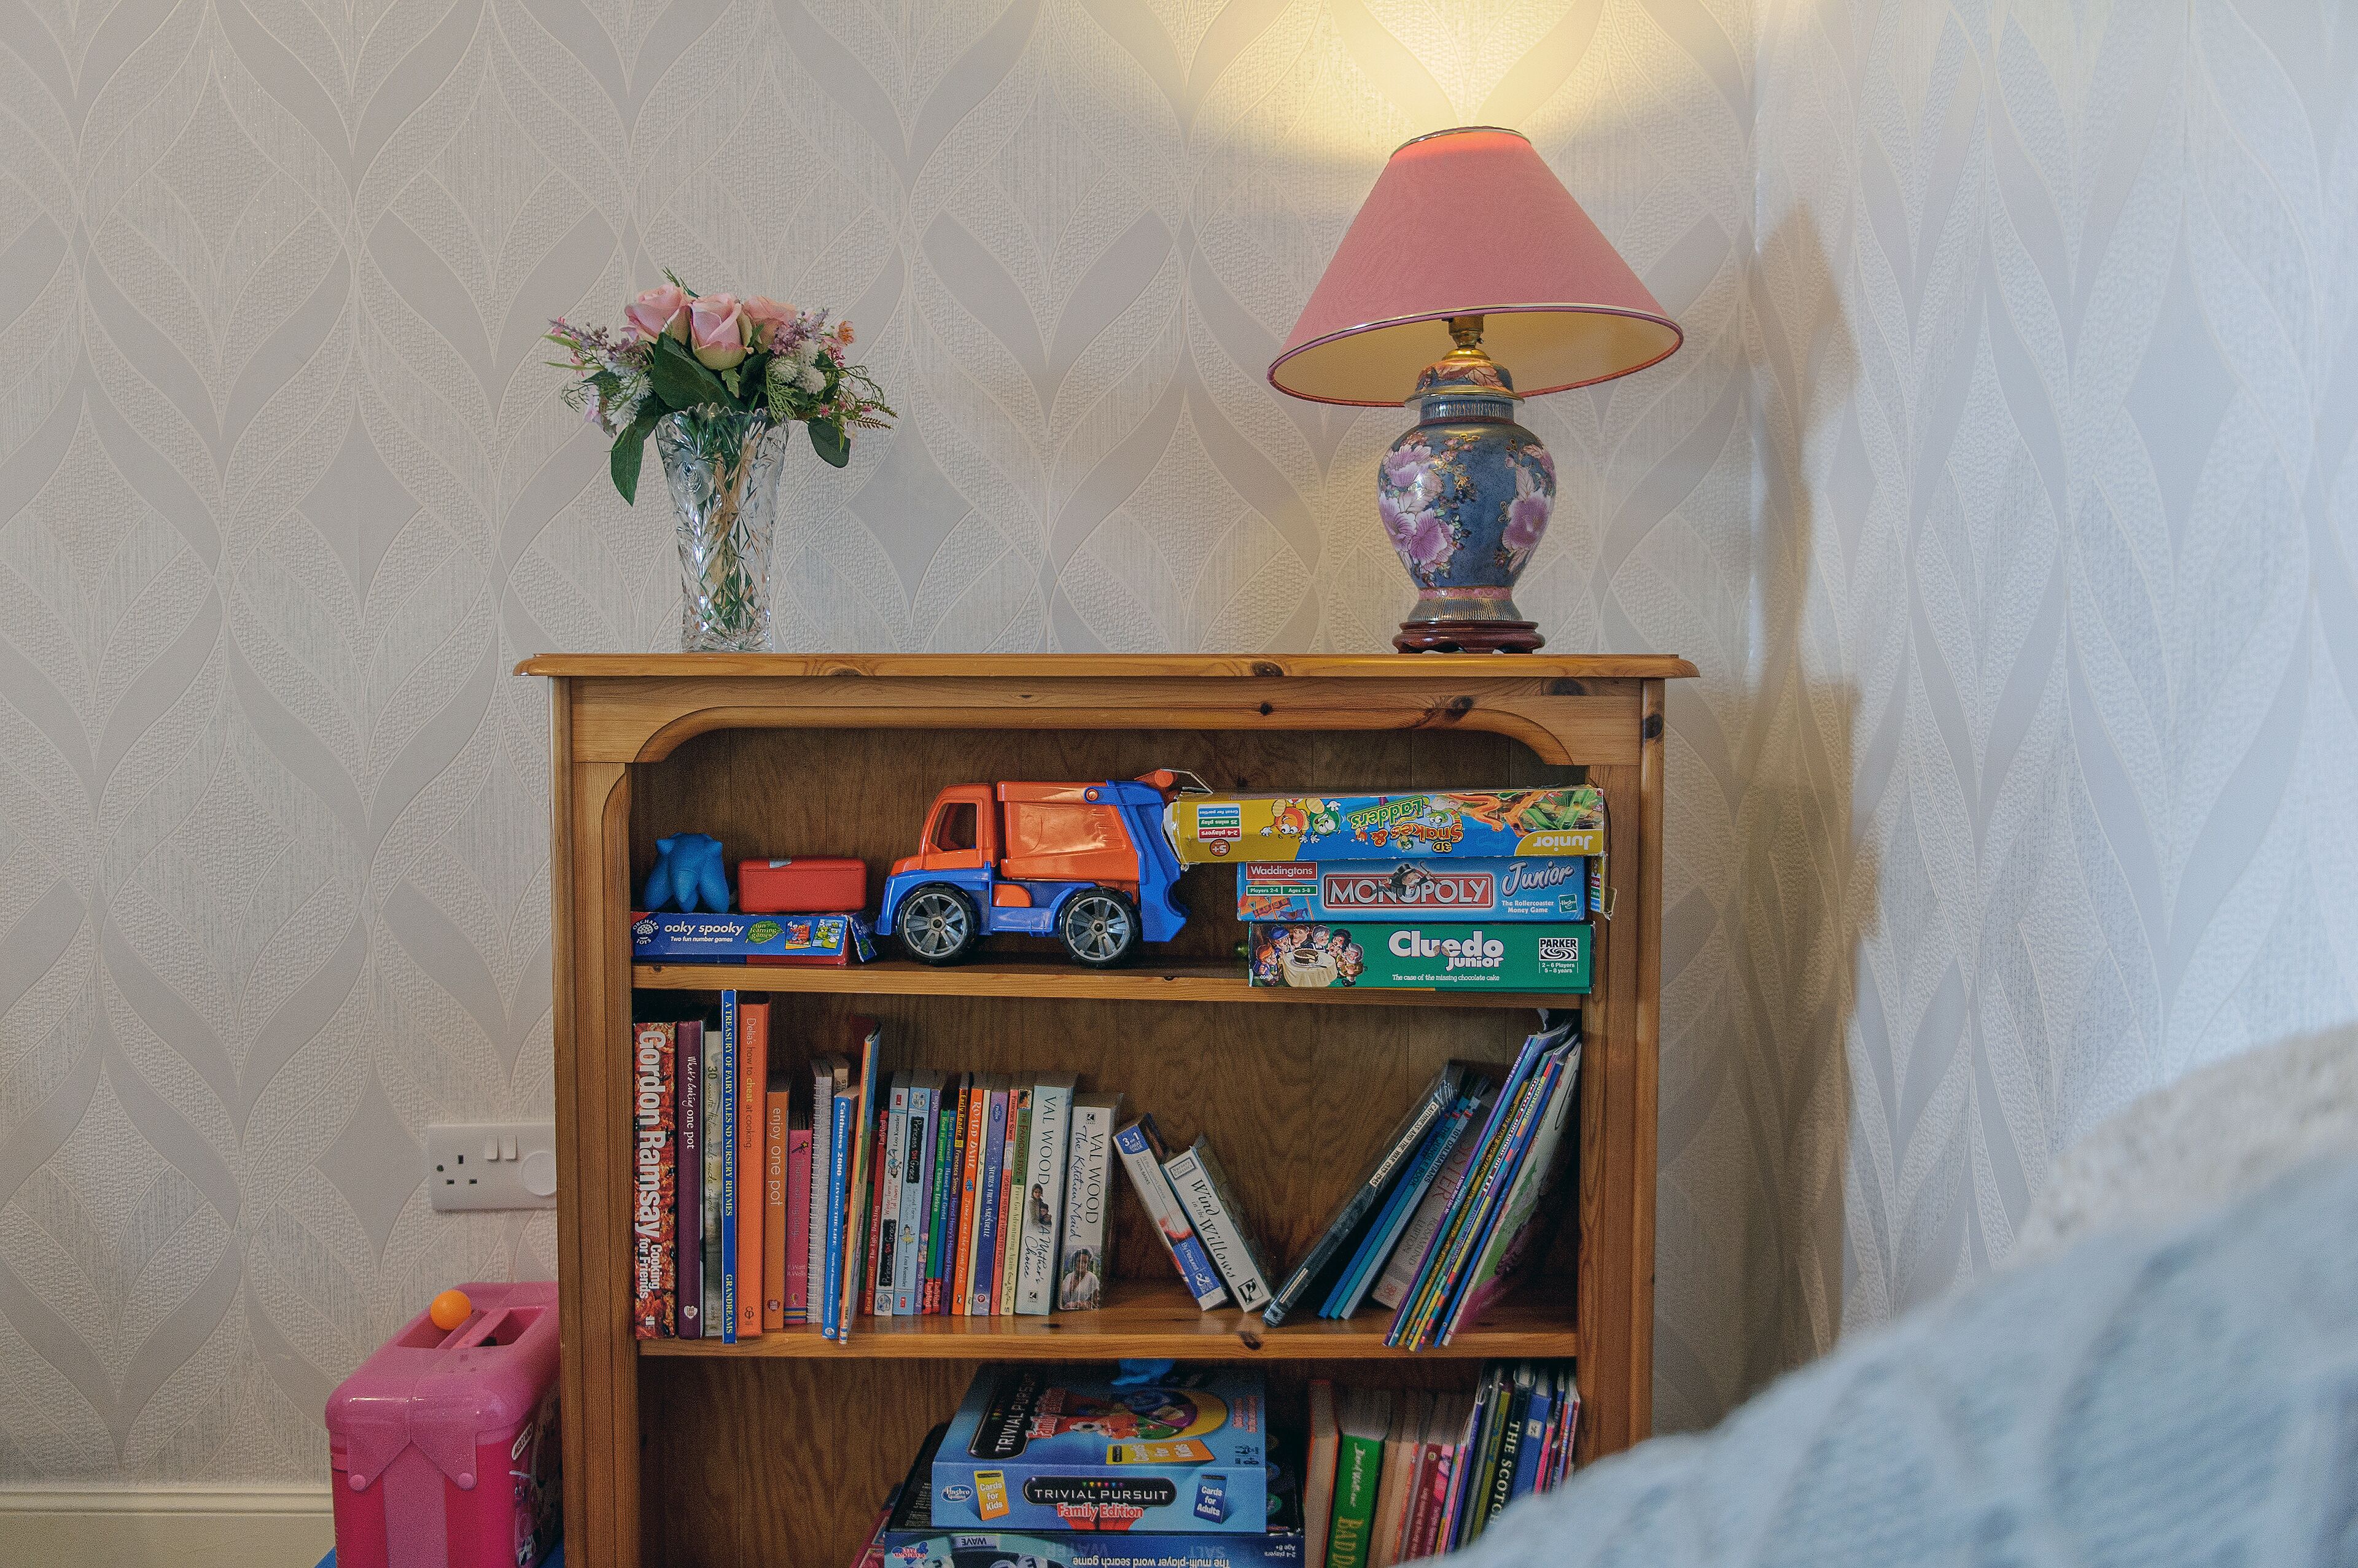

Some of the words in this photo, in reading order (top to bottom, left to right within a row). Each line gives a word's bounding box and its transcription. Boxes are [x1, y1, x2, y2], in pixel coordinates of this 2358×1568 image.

[1350, 798, 1423, 829] Ladders
[1369, 829, 1389, 847] &
[1390, 823, 1463, 844] Snakes
[1533, 835, 1593, 852] Junior
[1212, 845, 1227, 853] 5+
[1432, 840, 1453, 853] 3D
[1250, 865, 1313, 877] Waddingtons
[1501, 860, 1575, 897] Junior
[1329, 879, 1487, 904] MONOPOLY
[632, 919, 659, 931] ORCHARD
[664, 921, 696, 936] ooky
[698, 922, 744, 936] spooky
[1387, 929, 1505, 958] Cluedo
[1539, 939, 1576, 948] PARKER
[1446, 956, 1504, 972] junior
[746, 1018, 757, 1045] Delia's
[725, 1056, 733, 1068] OF
[746, 1047, 755, 1063] how
[639, 1030, 666, 1125] Gordon
[687, 1056, 697, 1082] What's
[707, 1066, 717, 1079] 30
[746, 1067, 753, 1076] to
[682, 1082, 697, 1107] Cooking
[745, 1077, 755, 1103] cheat
[970, 1101, 981, 1136] ROALD
[1042, 1095, 1057, 1124] VAL
[1414, 1102, 1437, 1131] CAITHNESS
[707, 1111, 718, 1135] Italian
[769, 1108, 782, 1139] enjoy
[957, 1114, 966, 1137] Reader
[1405, 1128, 1417, 1141] AND
[1438, 1125, 1450, 1140] THE
[1450, 1127, 1461, 1139] 101
[683, 1131, 696, 1149] pot
[1075, 1125, 1088, 1152] The
[1089, 1133, 1104, 1162] VAL
[1397, 1139, 1408, 1151] THE
[771, 1146, 782, 1175] one
[967, 1140, 978, 1169] DAHL
[1037, 1130, 1054, 1185] WOOD
[1389, 1149, 1401, 1162] WAR
[1421, 1138, 1442, 1168] JUNGLE
[1423, 1138, 1454, 1184] DALMATIANS
[635, 1131, 666, 1238] Ramsay
[707, 1162, 717, 1184] made
[1070, 1155, 1085, 1200] Kitchen
[1371, 1160, 1392, 1186] 1939-1945
[1409, 1166, 1425, 1188] BOOK
[706, 1187, 715, 1213] simple
[768, 1180, 783, 1206] pot
[986, 1189, 994, 1204] FROM
[1014, 1187, 1023, 1200] Five
[1085, 1166, 1102, 1224] WOOD
[1191, 1179, 1220, 1216] Wind
[1013, 1201, 1021, 1211] Go
[1191, 1200, 1199, 1208] in
[1196, 1208, 1205, 1219] the
[871, 1205, 880, 1232] Duckling
[982, 1206, 992, 1238] ARENDELLE
[1037, 1225, 1048, 1235] A
[1068, 1201, 1082, 1241] Maid
[997, 1222, 1006, 1248] HAUNTED
[1008, 1212, 1021, 1251] Adventuring
[639, 1238, 650, 1255] for
[1024, 1235, 1038, 1279] Choice
[1198, 1218, 1235, 1278] Willows
[648, 1244, 663, 1290] Cooking
[1007, 1252, 1016, 1270] Again
[1035, 1237, 1051, 1284] Mother's
[639, 1256, 651, 1299] Friends
[933, 1281, 941, 1306] Ladybird
[1502, 1419, 1522, 1454] THE
[943, 1486, 970, 1496] Hasbro
[979, 1482, 1003, 1491] Cards
[1034, 1489, 1098, 1500] TRIVIAL
[1100, 1490, 1168, 1500] PURSUIT
[1200, 1486, 1223, 1497] Cards
[986, 1501, 1003, 1511] Kids
[1056, 1502, 1099, 1521] Family
[1099, 1504, 1144, 1518] Edition
[1197, 1504, 1221, 1516] Adults
[1204, 1496, 1216, 1505] for
[961, 1537, 987, 1546] WAVE
[1334, 1516, 1364, 1553] BAD
[1072, 1556, 1099, 1564] game
[1100, 1558, 1130, 1567] search
[1132, 1558, 1155, 1567] word
